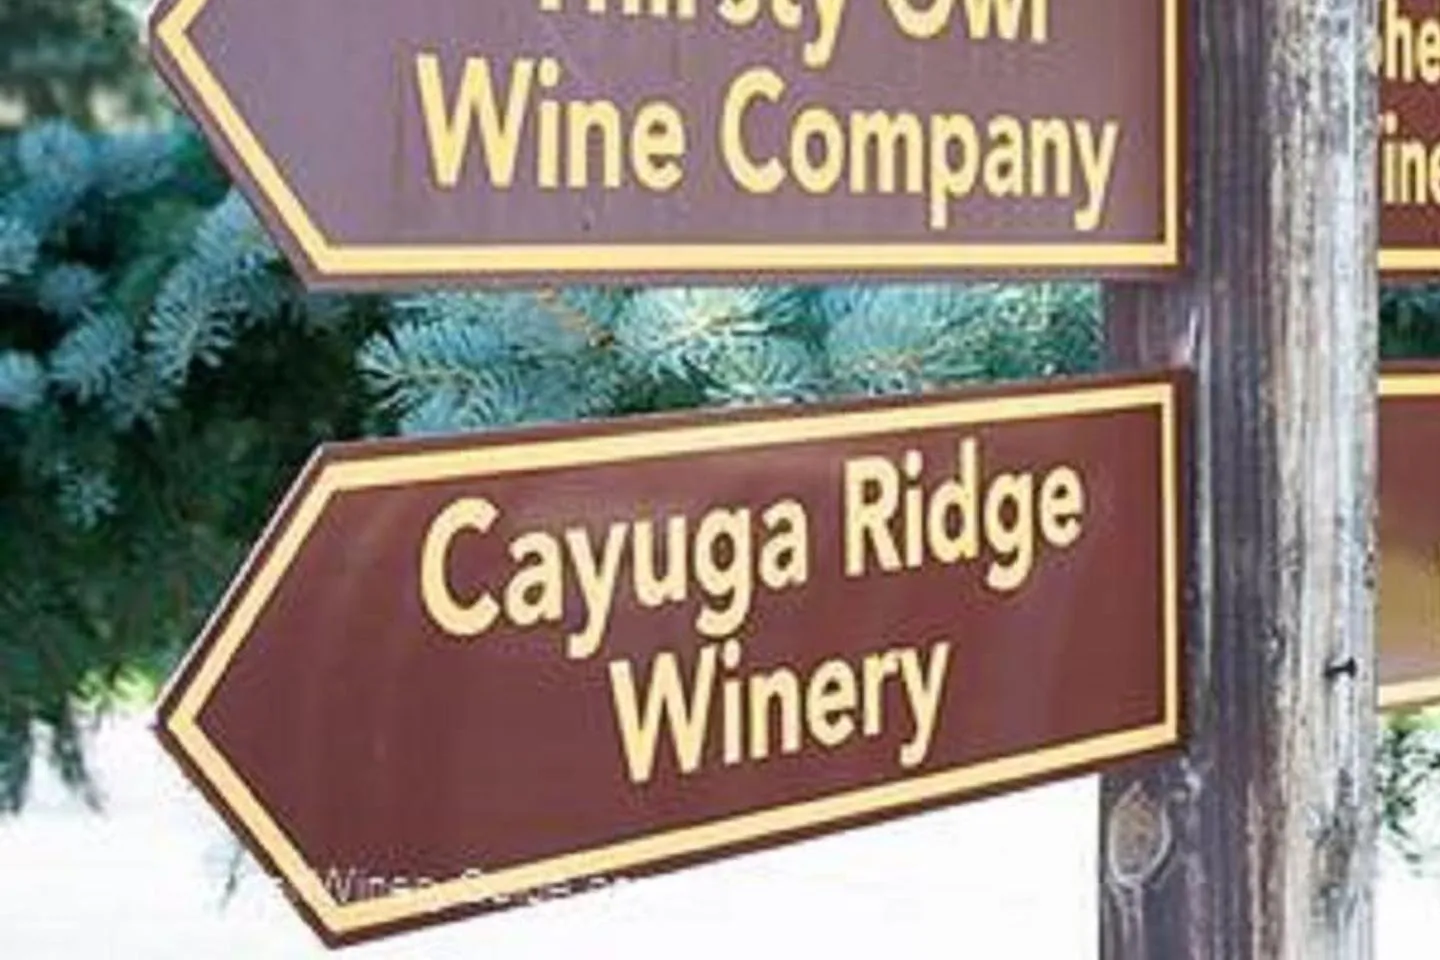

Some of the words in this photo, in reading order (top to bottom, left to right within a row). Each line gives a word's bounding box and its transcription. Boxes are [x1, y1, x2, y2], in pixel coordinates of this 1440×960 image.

[414, 51, 687, 192] Wine
[719, 65, 1120, 234] Company
[420, 495, 809, 662] Cayuga
[843, 436, 1085, 592] Ridge
[608, 639, 951, 784] Winery
